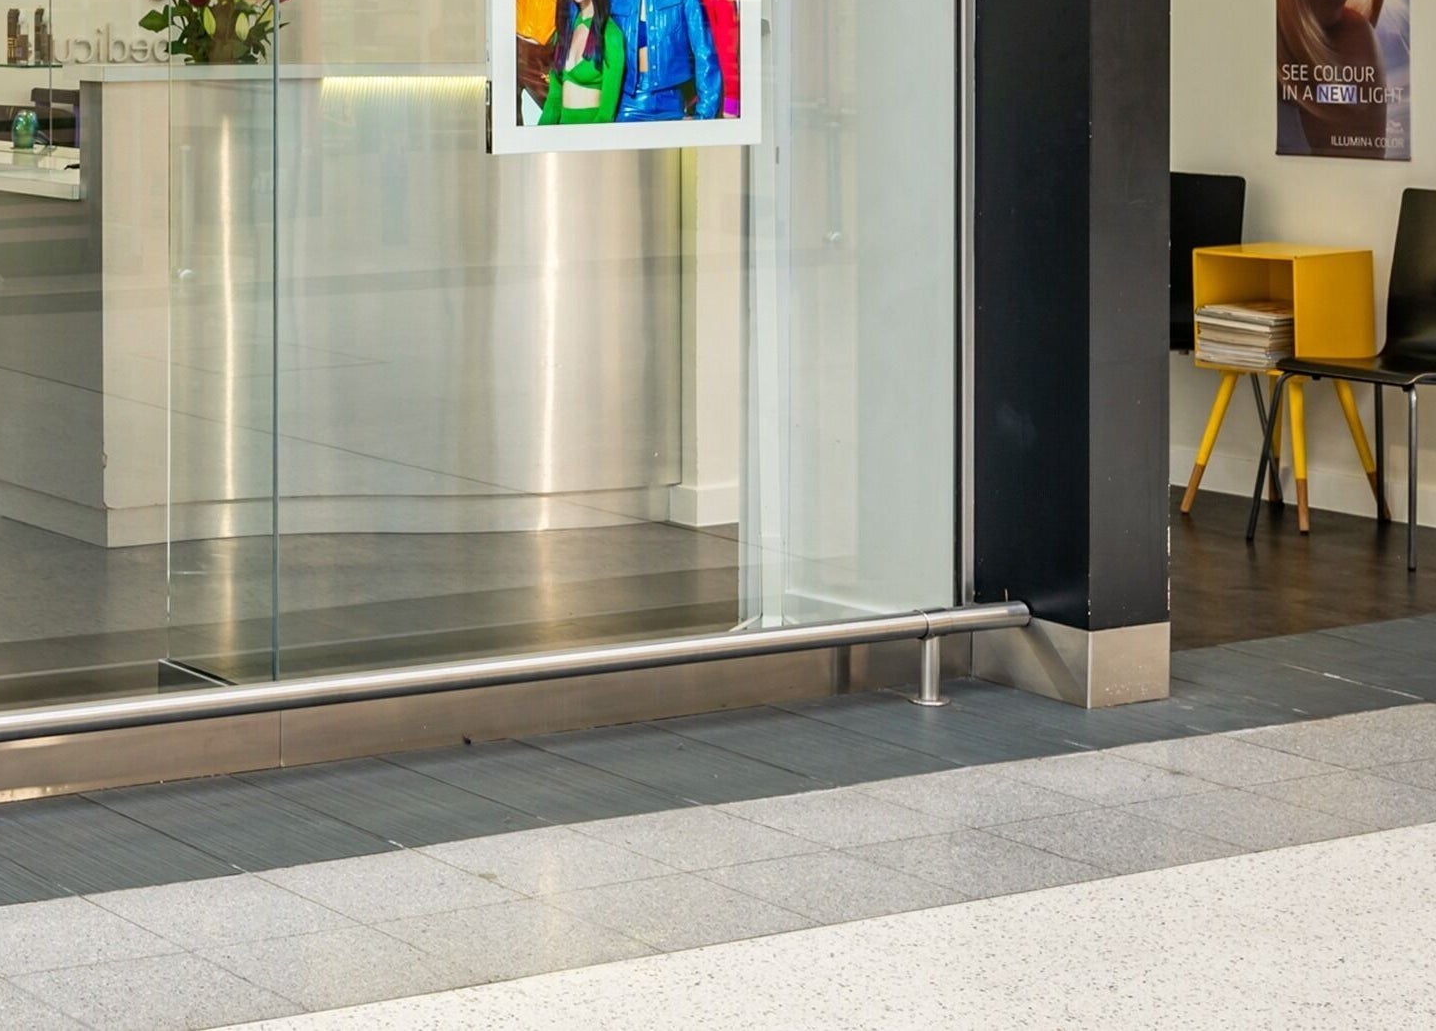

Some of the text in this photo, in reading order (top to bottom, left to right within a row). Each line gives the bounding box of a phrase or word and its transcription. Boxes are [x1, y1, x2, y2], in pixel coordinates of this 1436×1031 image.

[1282, 64, 1375, 83] SEE COLOUR
[1282, 84, 1404, 104] IN A NEW LIGHT
[1331, 135, 1404, 149] ILLUMINA COLOR
